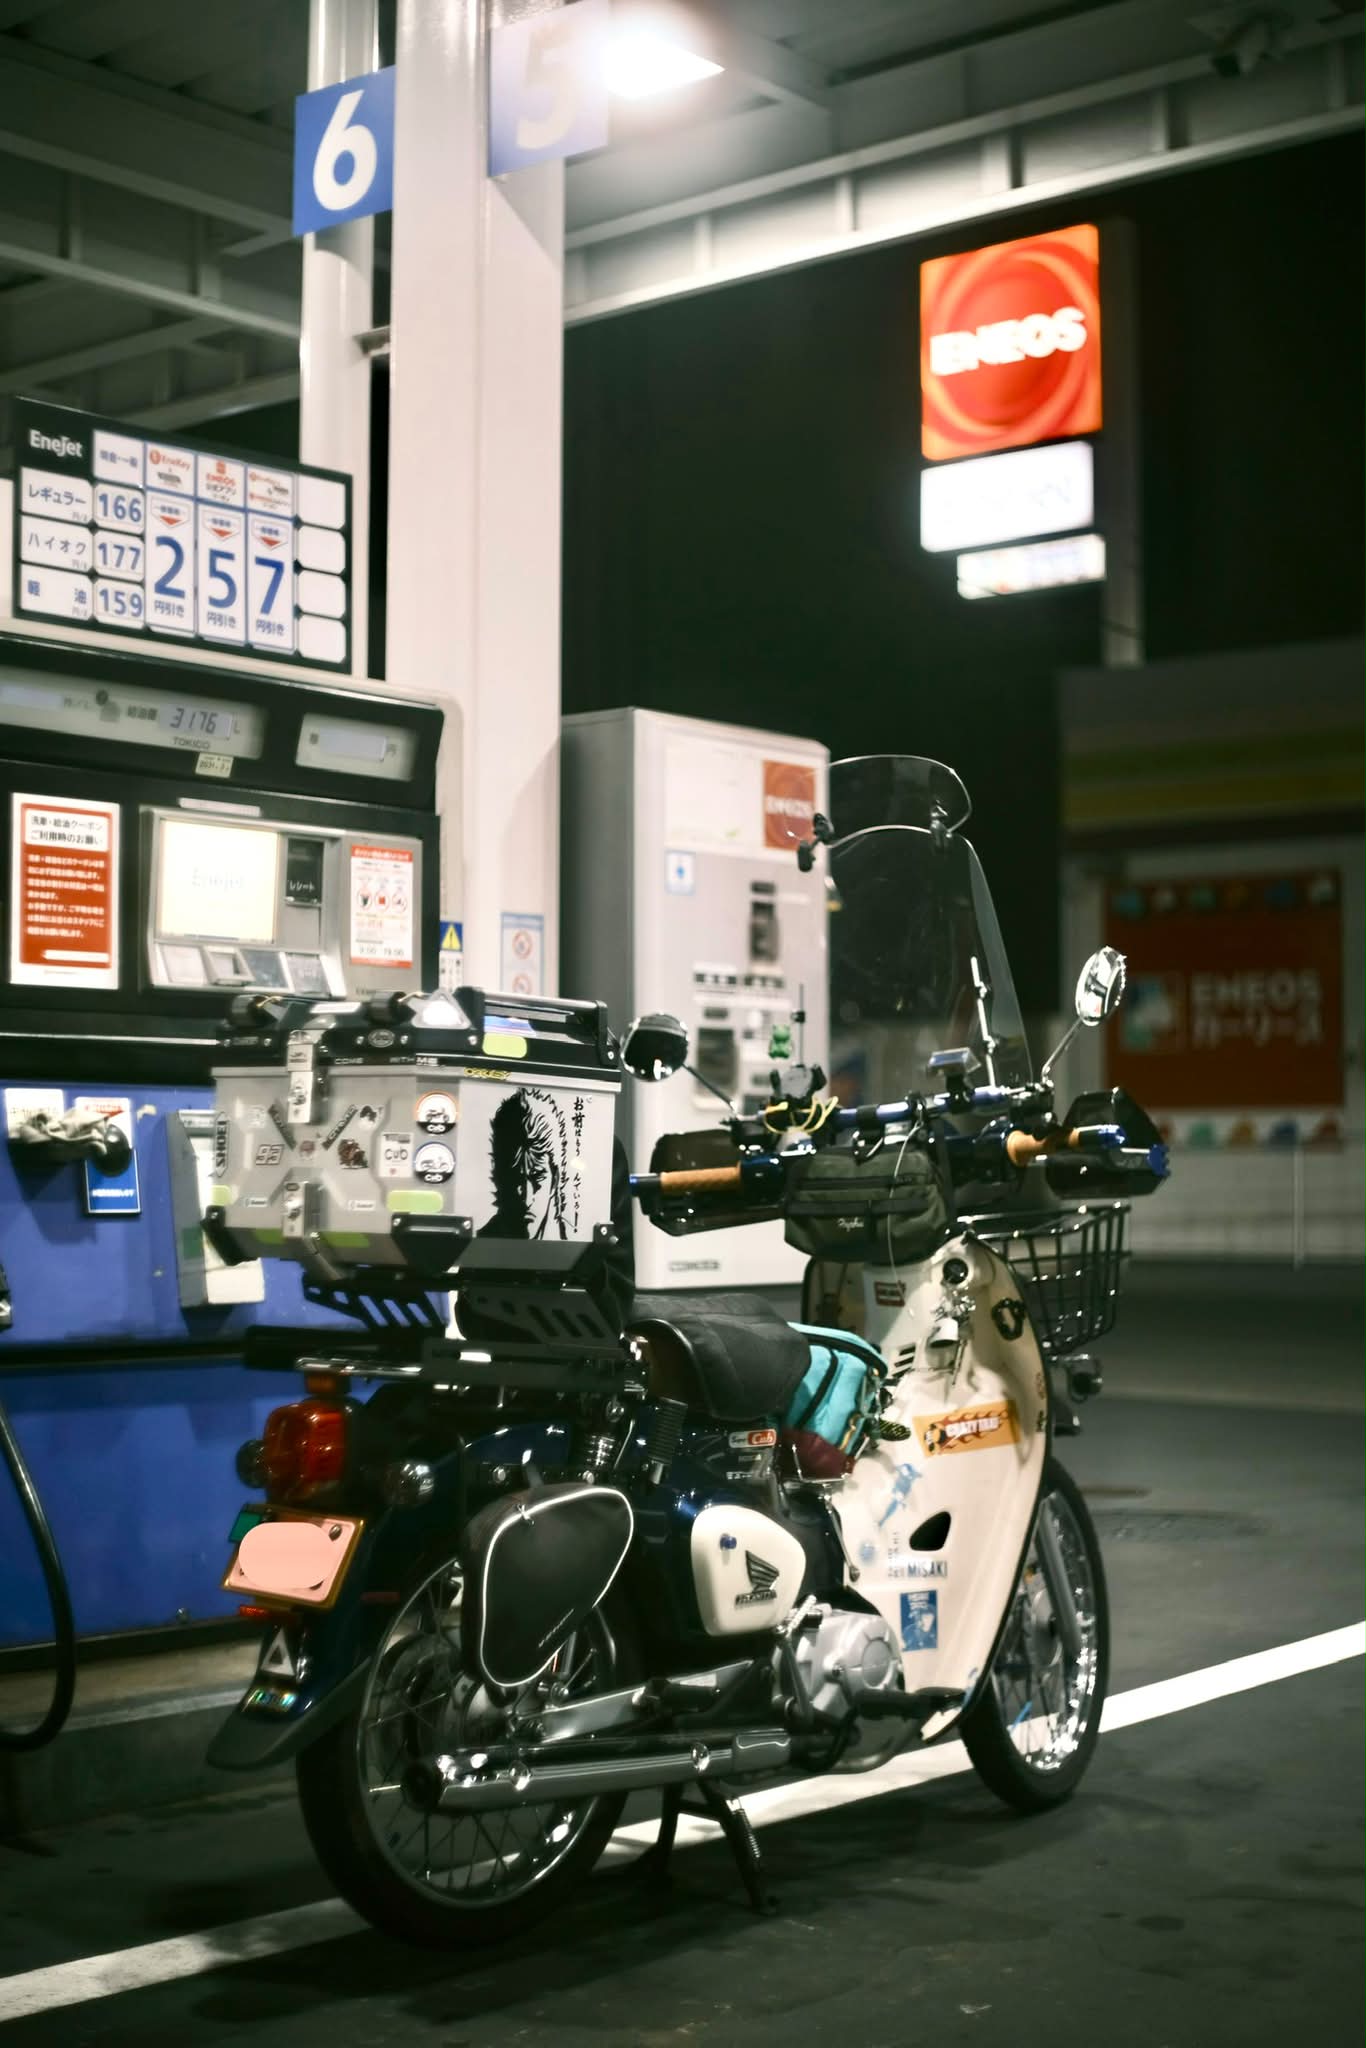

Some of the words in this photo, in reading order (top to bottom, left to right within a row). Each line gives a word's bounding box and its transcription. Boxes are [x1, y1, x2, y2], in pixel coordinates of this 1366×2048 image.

[313, 89, 378, 211] 6
[30, 429, 83, 458] Enejet
[28, 484, 87, 505] レギュラー
[99, 493, 142, 522] 166
[28, 532, 87, 555] ハイオク
[98, 542, 141, 571] 177
[154, 536, 185, 600] 2
[207, 548, 237, 609] 5
[255, 556, 285, 615] 7
[99, 588, 143, 618] 159
[154, 600, 185, 619] 円引き
[207, 611, 238, 629] 円引き
[256, 618, 285, 636] 円引き
[215, 1120, 228, 1168] SHOEI
[256, 1143, 285, 1166] 93
